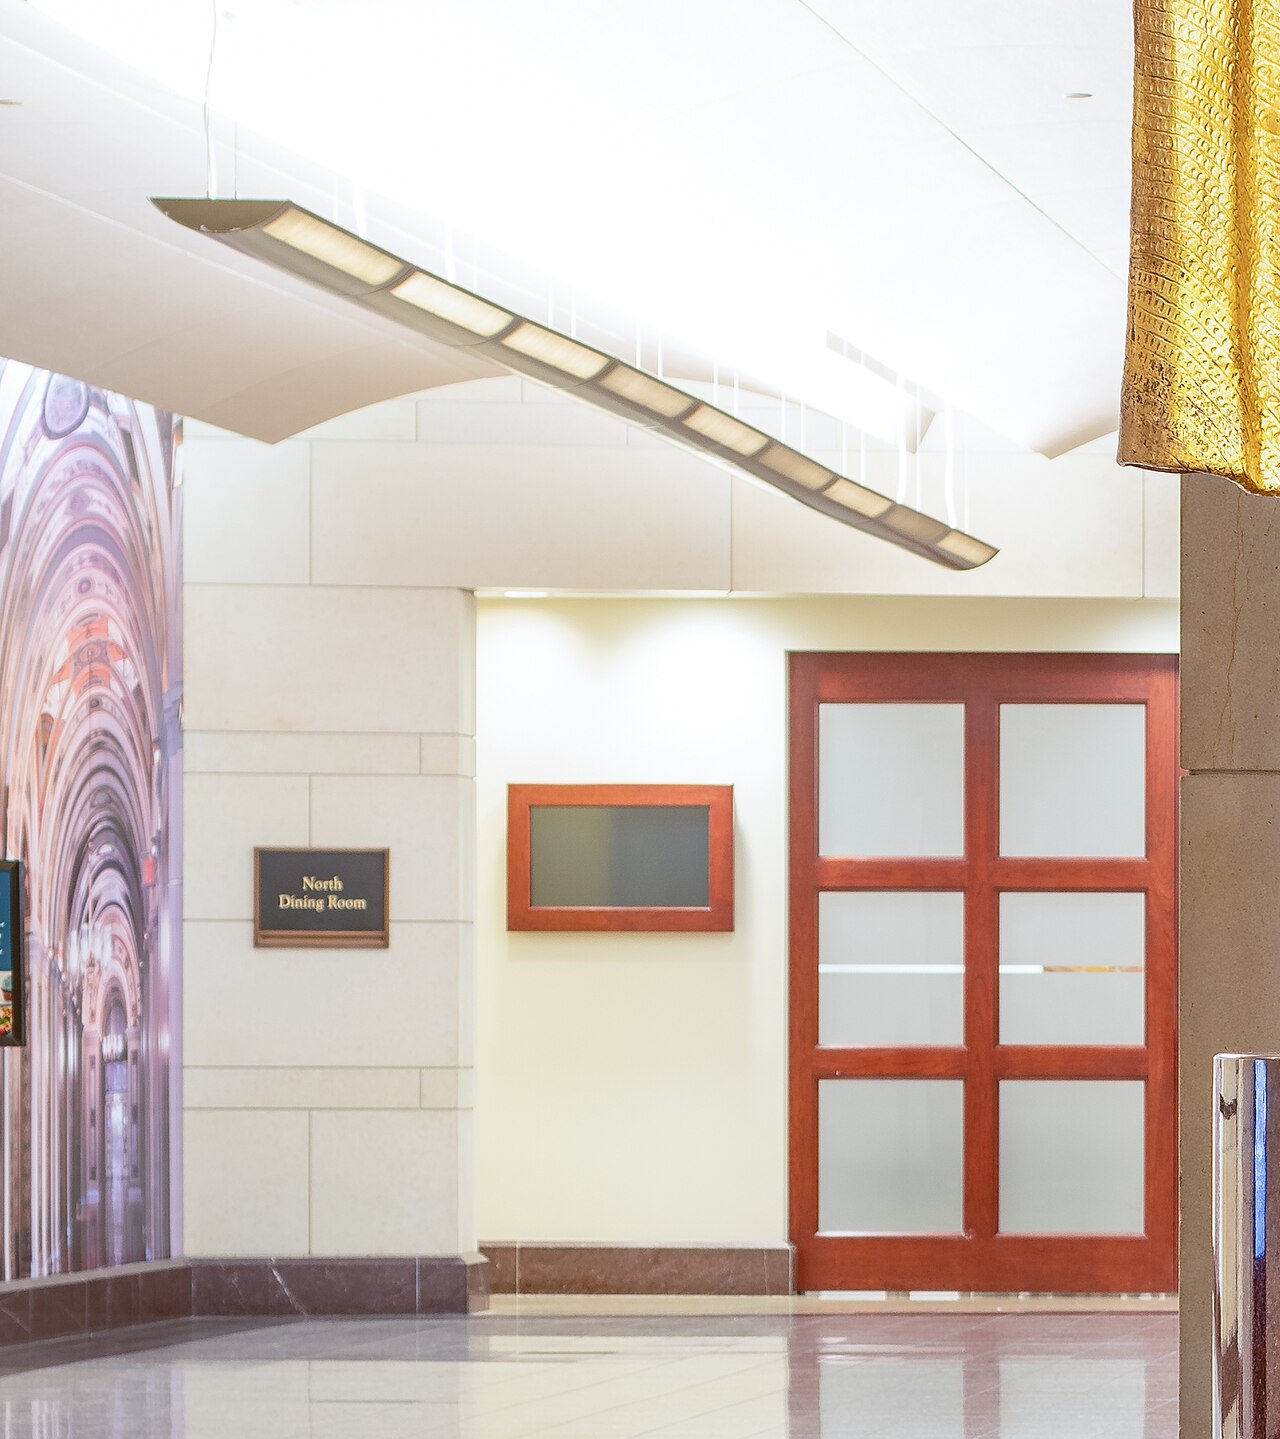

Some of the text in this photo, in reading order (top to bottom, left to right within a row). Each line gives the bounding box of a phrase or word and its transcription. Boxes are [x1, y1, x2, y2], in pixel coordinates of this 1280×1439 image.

[302, 876, 343, 891] North
[278, 894, 367, 912] Dining Room
